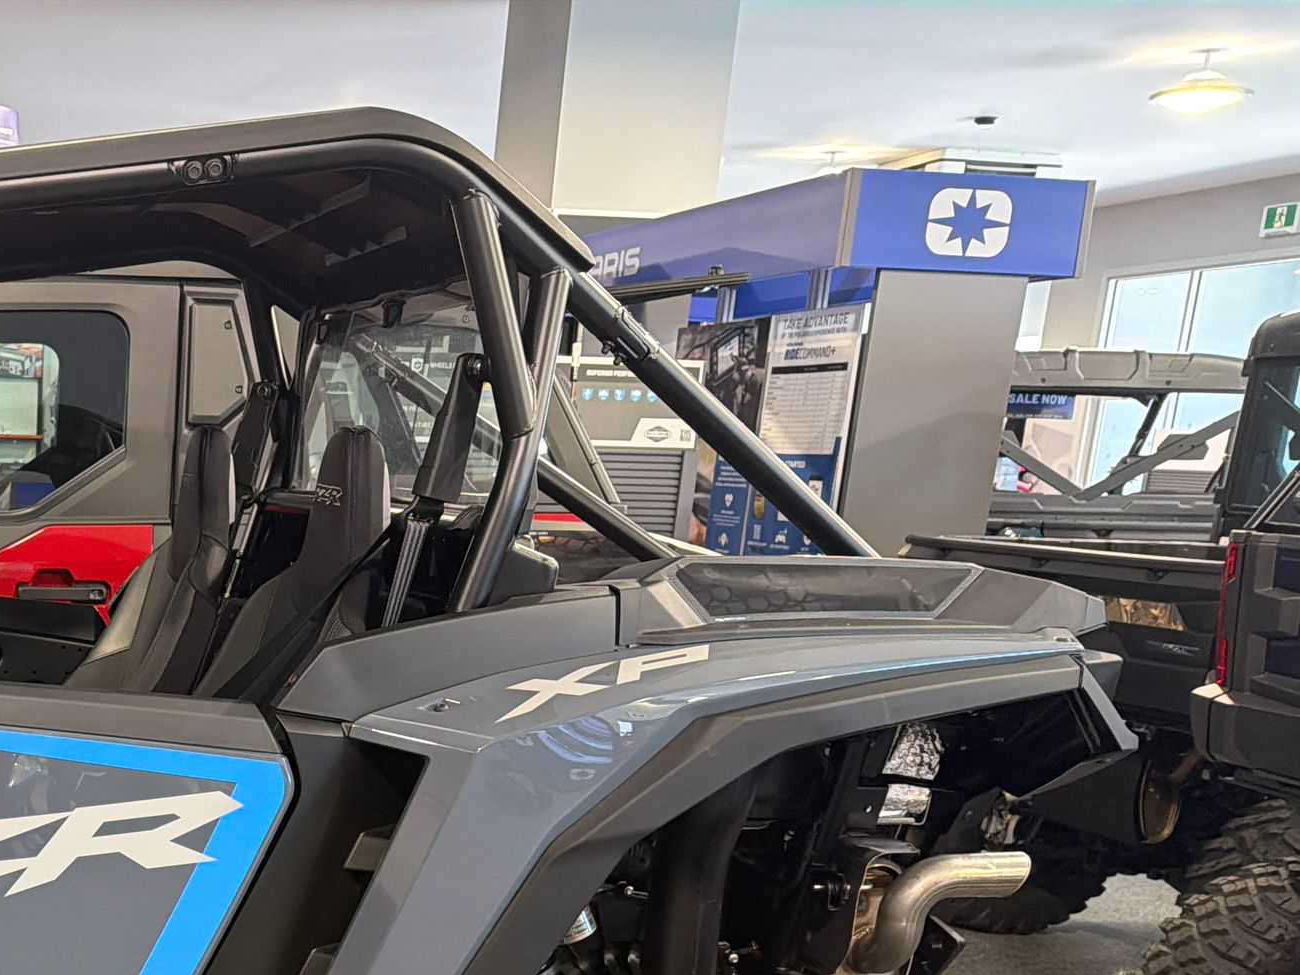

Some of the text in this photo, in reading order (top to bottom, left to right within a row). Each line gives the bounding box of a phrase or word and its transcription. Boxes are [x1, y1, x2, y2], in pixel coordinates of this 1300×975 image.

[783, 312, 850, 330] TAKE ADVANTAGE
[1008, 393, 1068, 405] SALE NOW
[495, 645, 709, 723] XP
